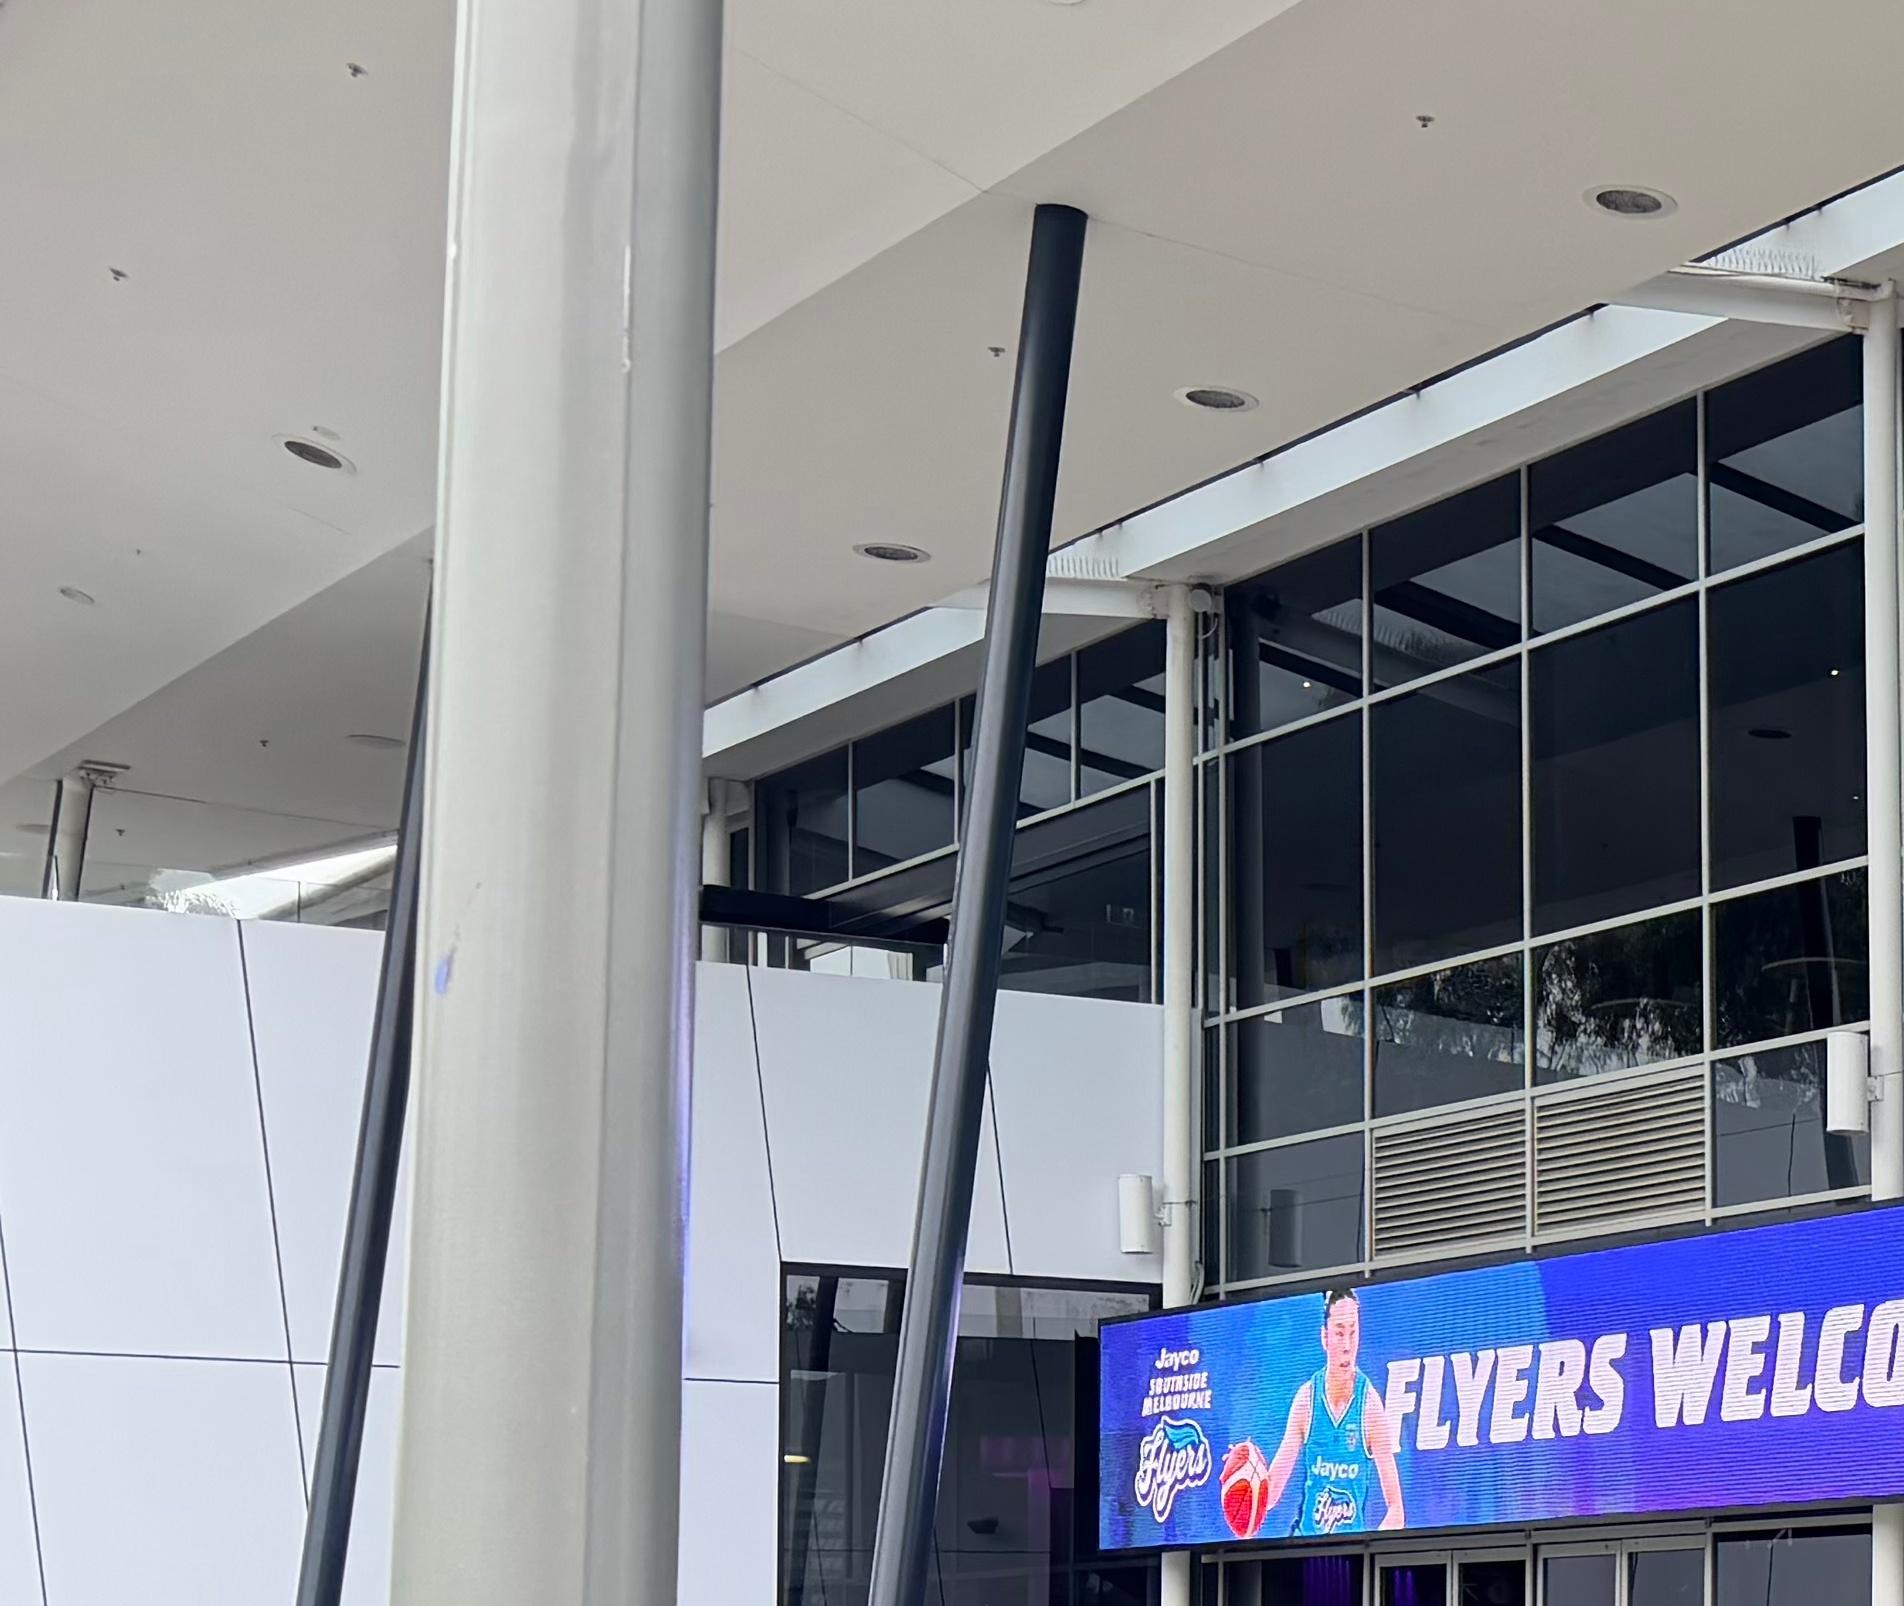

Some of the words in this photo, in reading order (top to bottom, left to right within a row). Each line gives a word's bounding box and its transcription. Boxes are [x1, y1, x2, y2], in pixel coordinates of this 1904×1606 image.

[1155, 1348, 1200, 1371] Jayco
[1149, 1372, 1209, 1395] SOUTHSIDE
[1386, 1333, 1629, 1453] FLYERS
[1137, 1422, 1209, 1516] Flyers
[1312, 1456, 1360, 1481] Jayco
